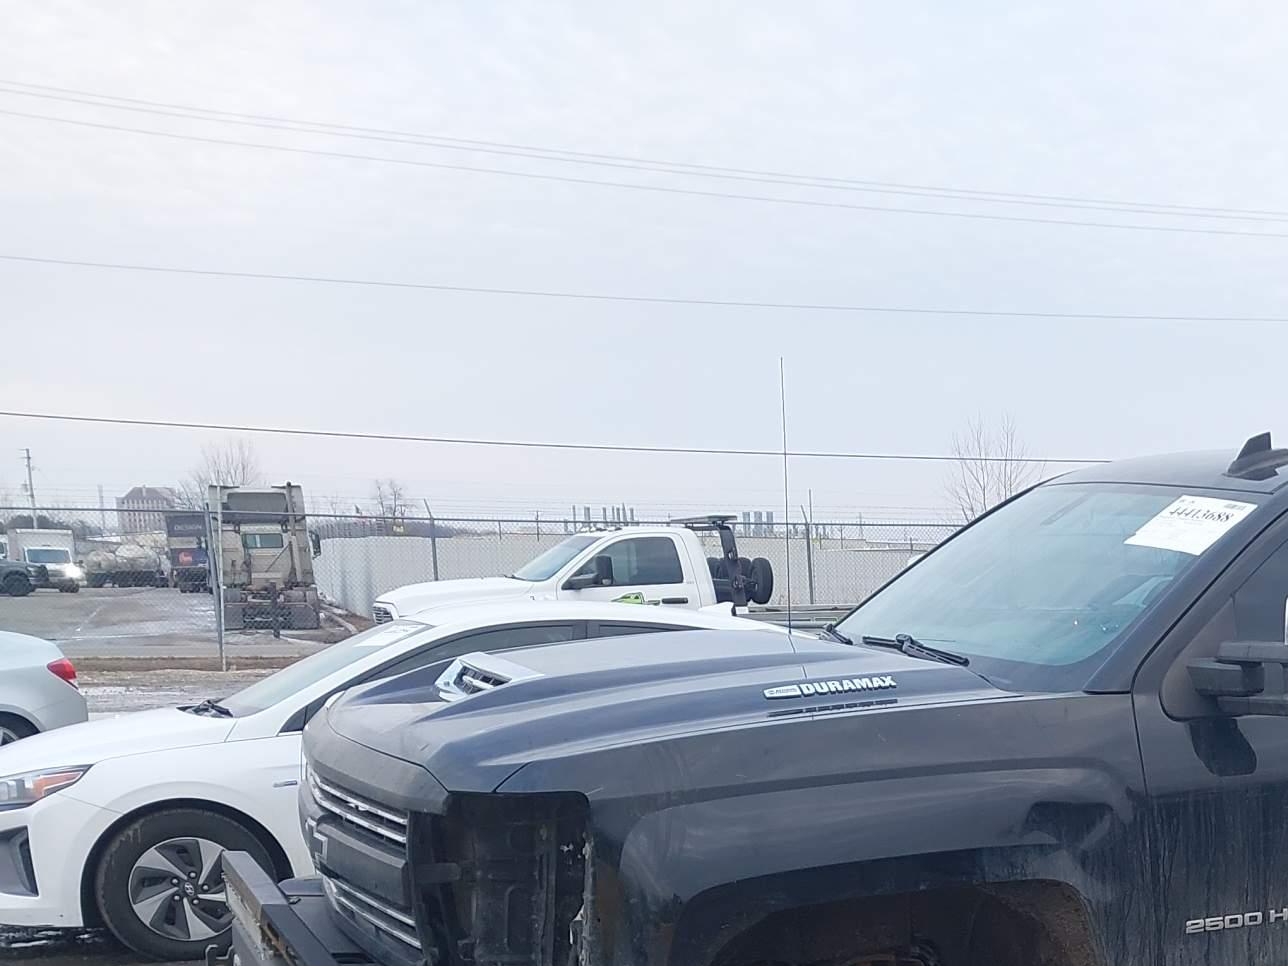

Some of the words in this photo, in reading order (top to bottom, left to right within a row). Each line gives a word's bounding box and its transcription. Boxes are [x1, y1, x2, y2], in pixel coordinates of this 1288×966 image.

[1170, 506, 1234, 523] 44413688
[800, 675, 897, 697] DURAMAX
[1185, 911, 1263, 934] 2500
